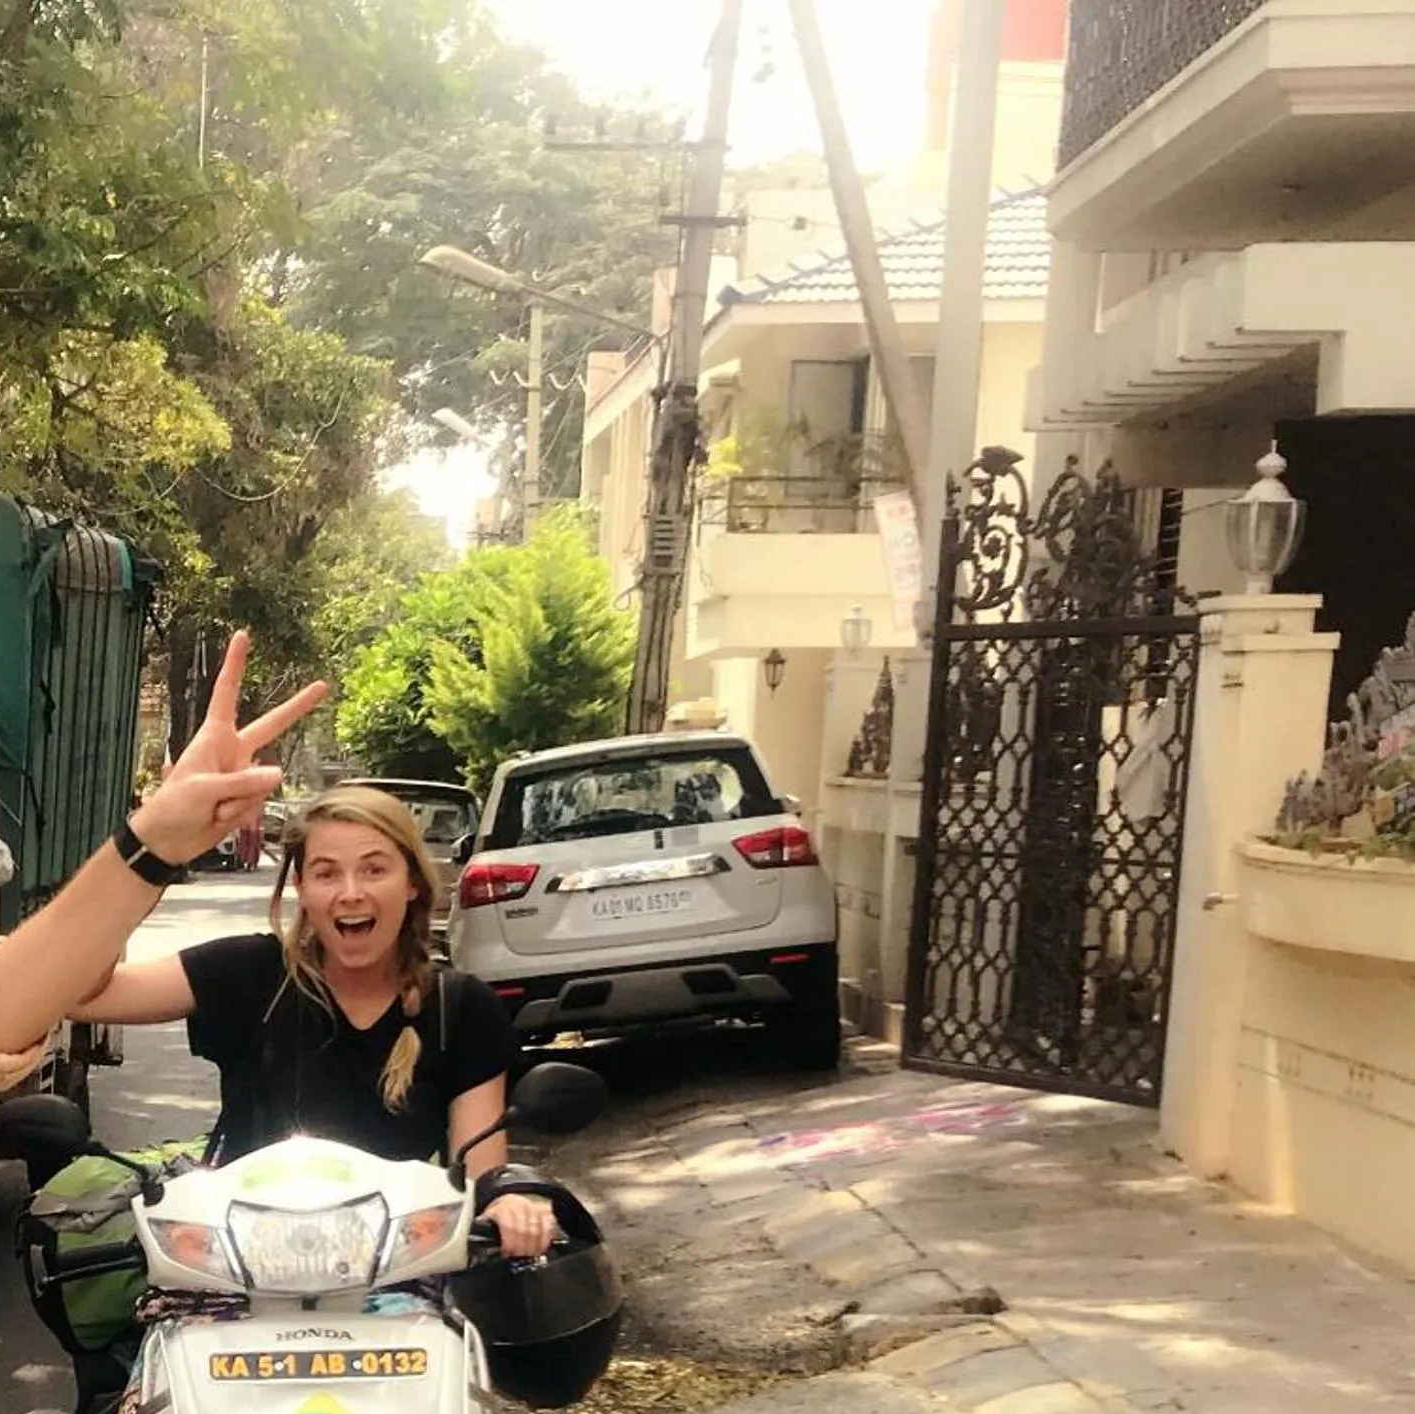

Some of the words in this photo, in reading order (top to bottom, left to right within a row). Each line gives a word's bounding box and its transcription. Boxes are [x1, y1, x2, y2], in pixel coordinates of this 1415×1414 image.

[276, 1327, 355, 1342] HONDA
[212, 1355, 250, 1378] KA
[310, 1353, 346, 1375] AB
